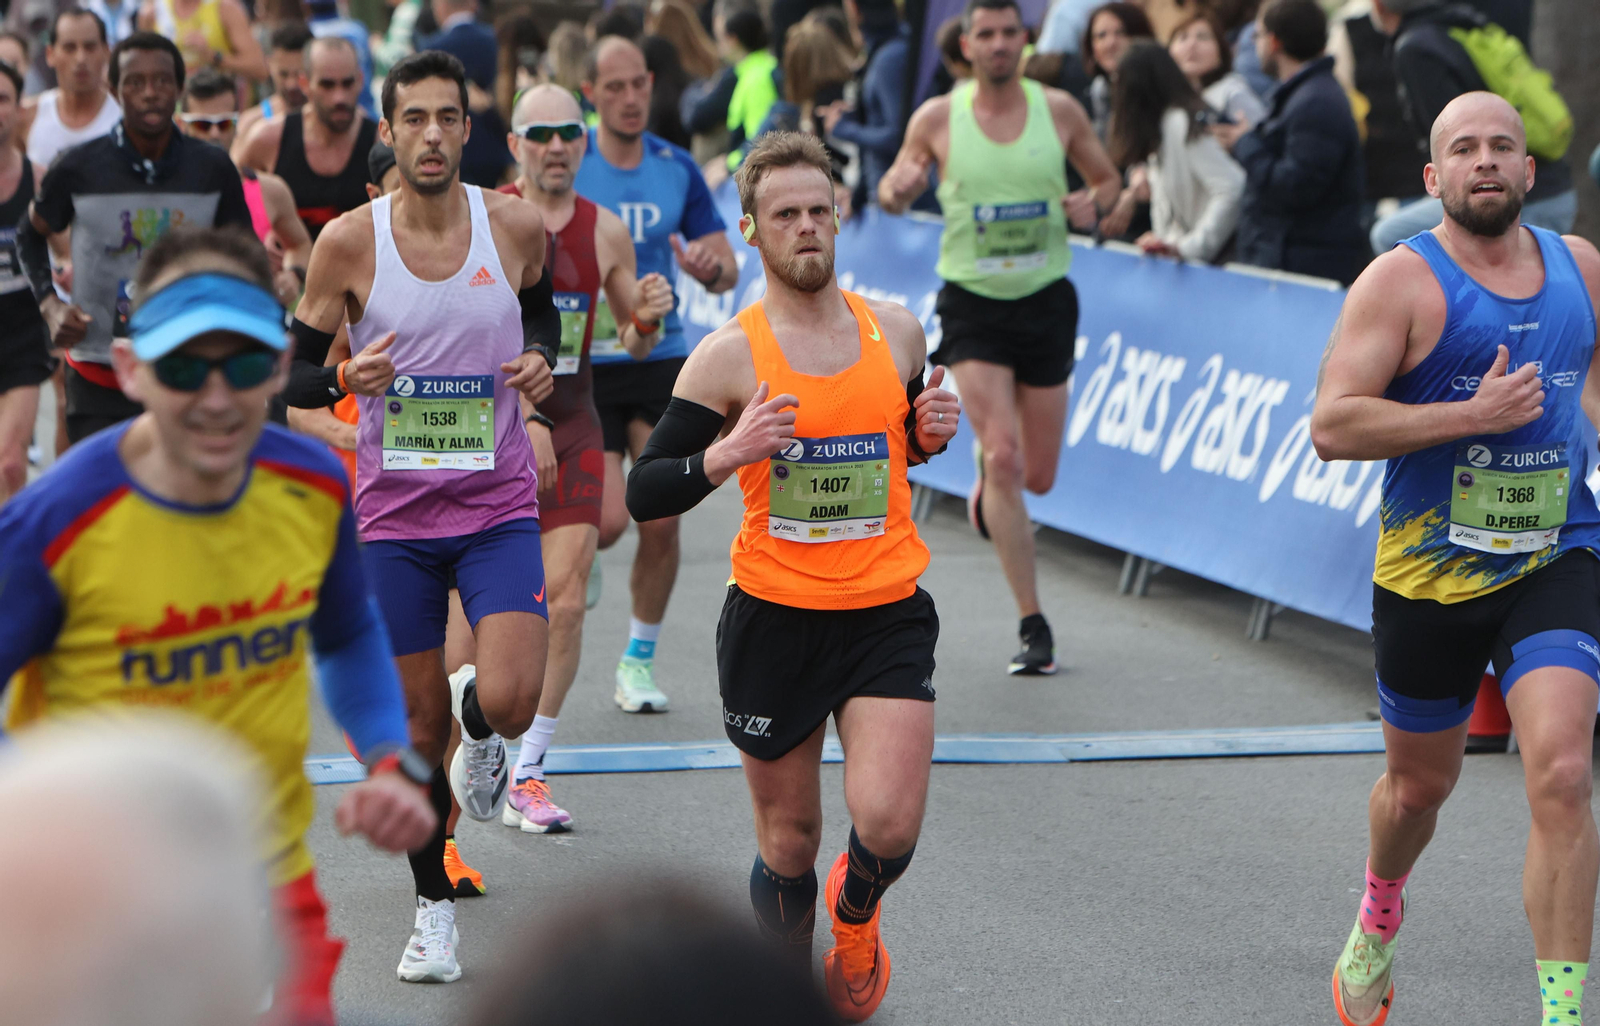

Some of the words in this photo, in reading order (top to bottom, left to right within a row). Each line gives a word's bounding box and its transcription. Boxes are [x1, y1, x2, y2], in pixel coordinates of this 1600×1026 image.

[469, 278, 496, 287] adidas
[422, 381, 481, 394] ZURICH
[421, 411, 457, 426] 1538
[394, 434, 435, 449] MARÍA
[438, 437, 446, 449] Y
[449, 437, 484, 449] ALMA
[812, 441, 876, 458] ZURICH
[1500, 449, 1559, 468] ZURICH
[810, 477, 850, 494] 1407
[1496, 486, 1535, 504] 1368
[809, 504, 849, 519] ADAM
[1485, 513, 1541, 529] D.PEREZ
[781, 525, 797, 533] asics
[1463, 532, 1479, 541] asics
